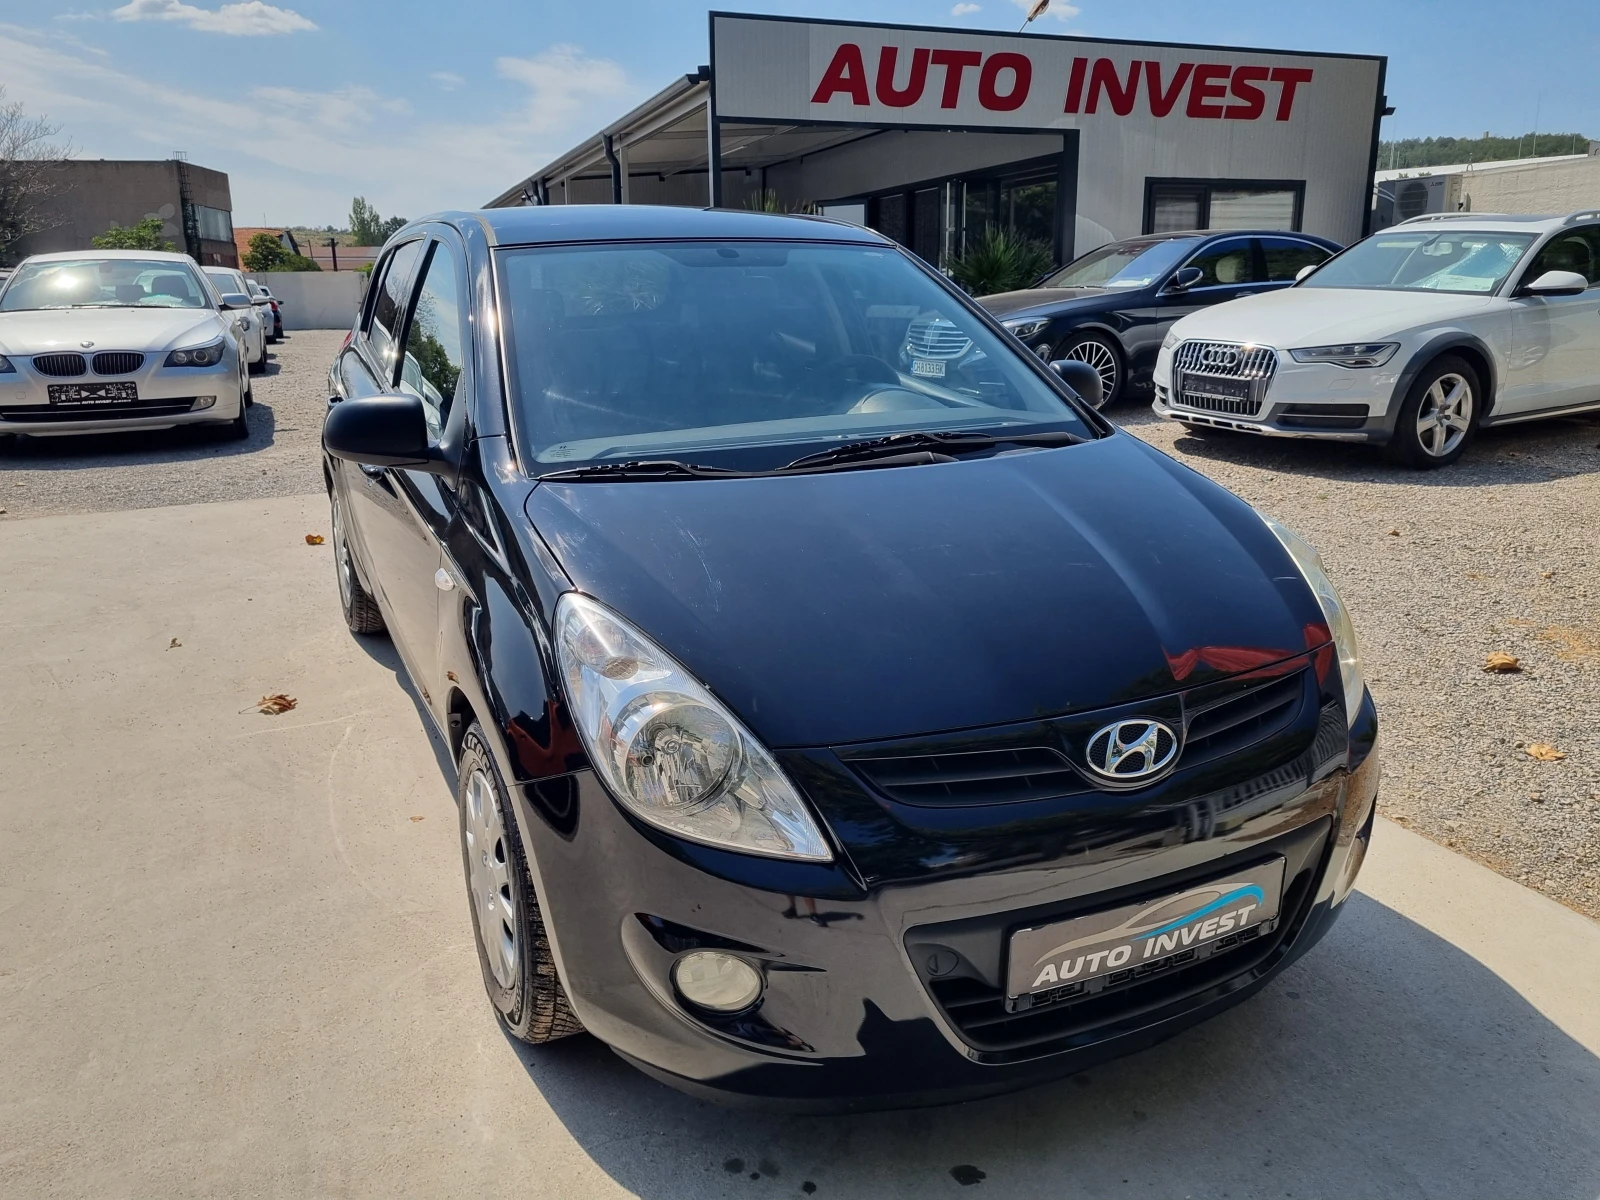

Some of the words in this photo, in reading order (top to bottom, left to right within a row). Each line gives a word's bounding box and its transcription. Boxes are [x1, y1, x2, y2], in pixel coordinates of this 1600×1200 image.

[812, 44, 1032, 111] AUTO
[1064, 57, 1313, 121] INVEST
[1032, 945, 1132, 987] AUTO
[1143, 904, 1256, 958] INVEST
